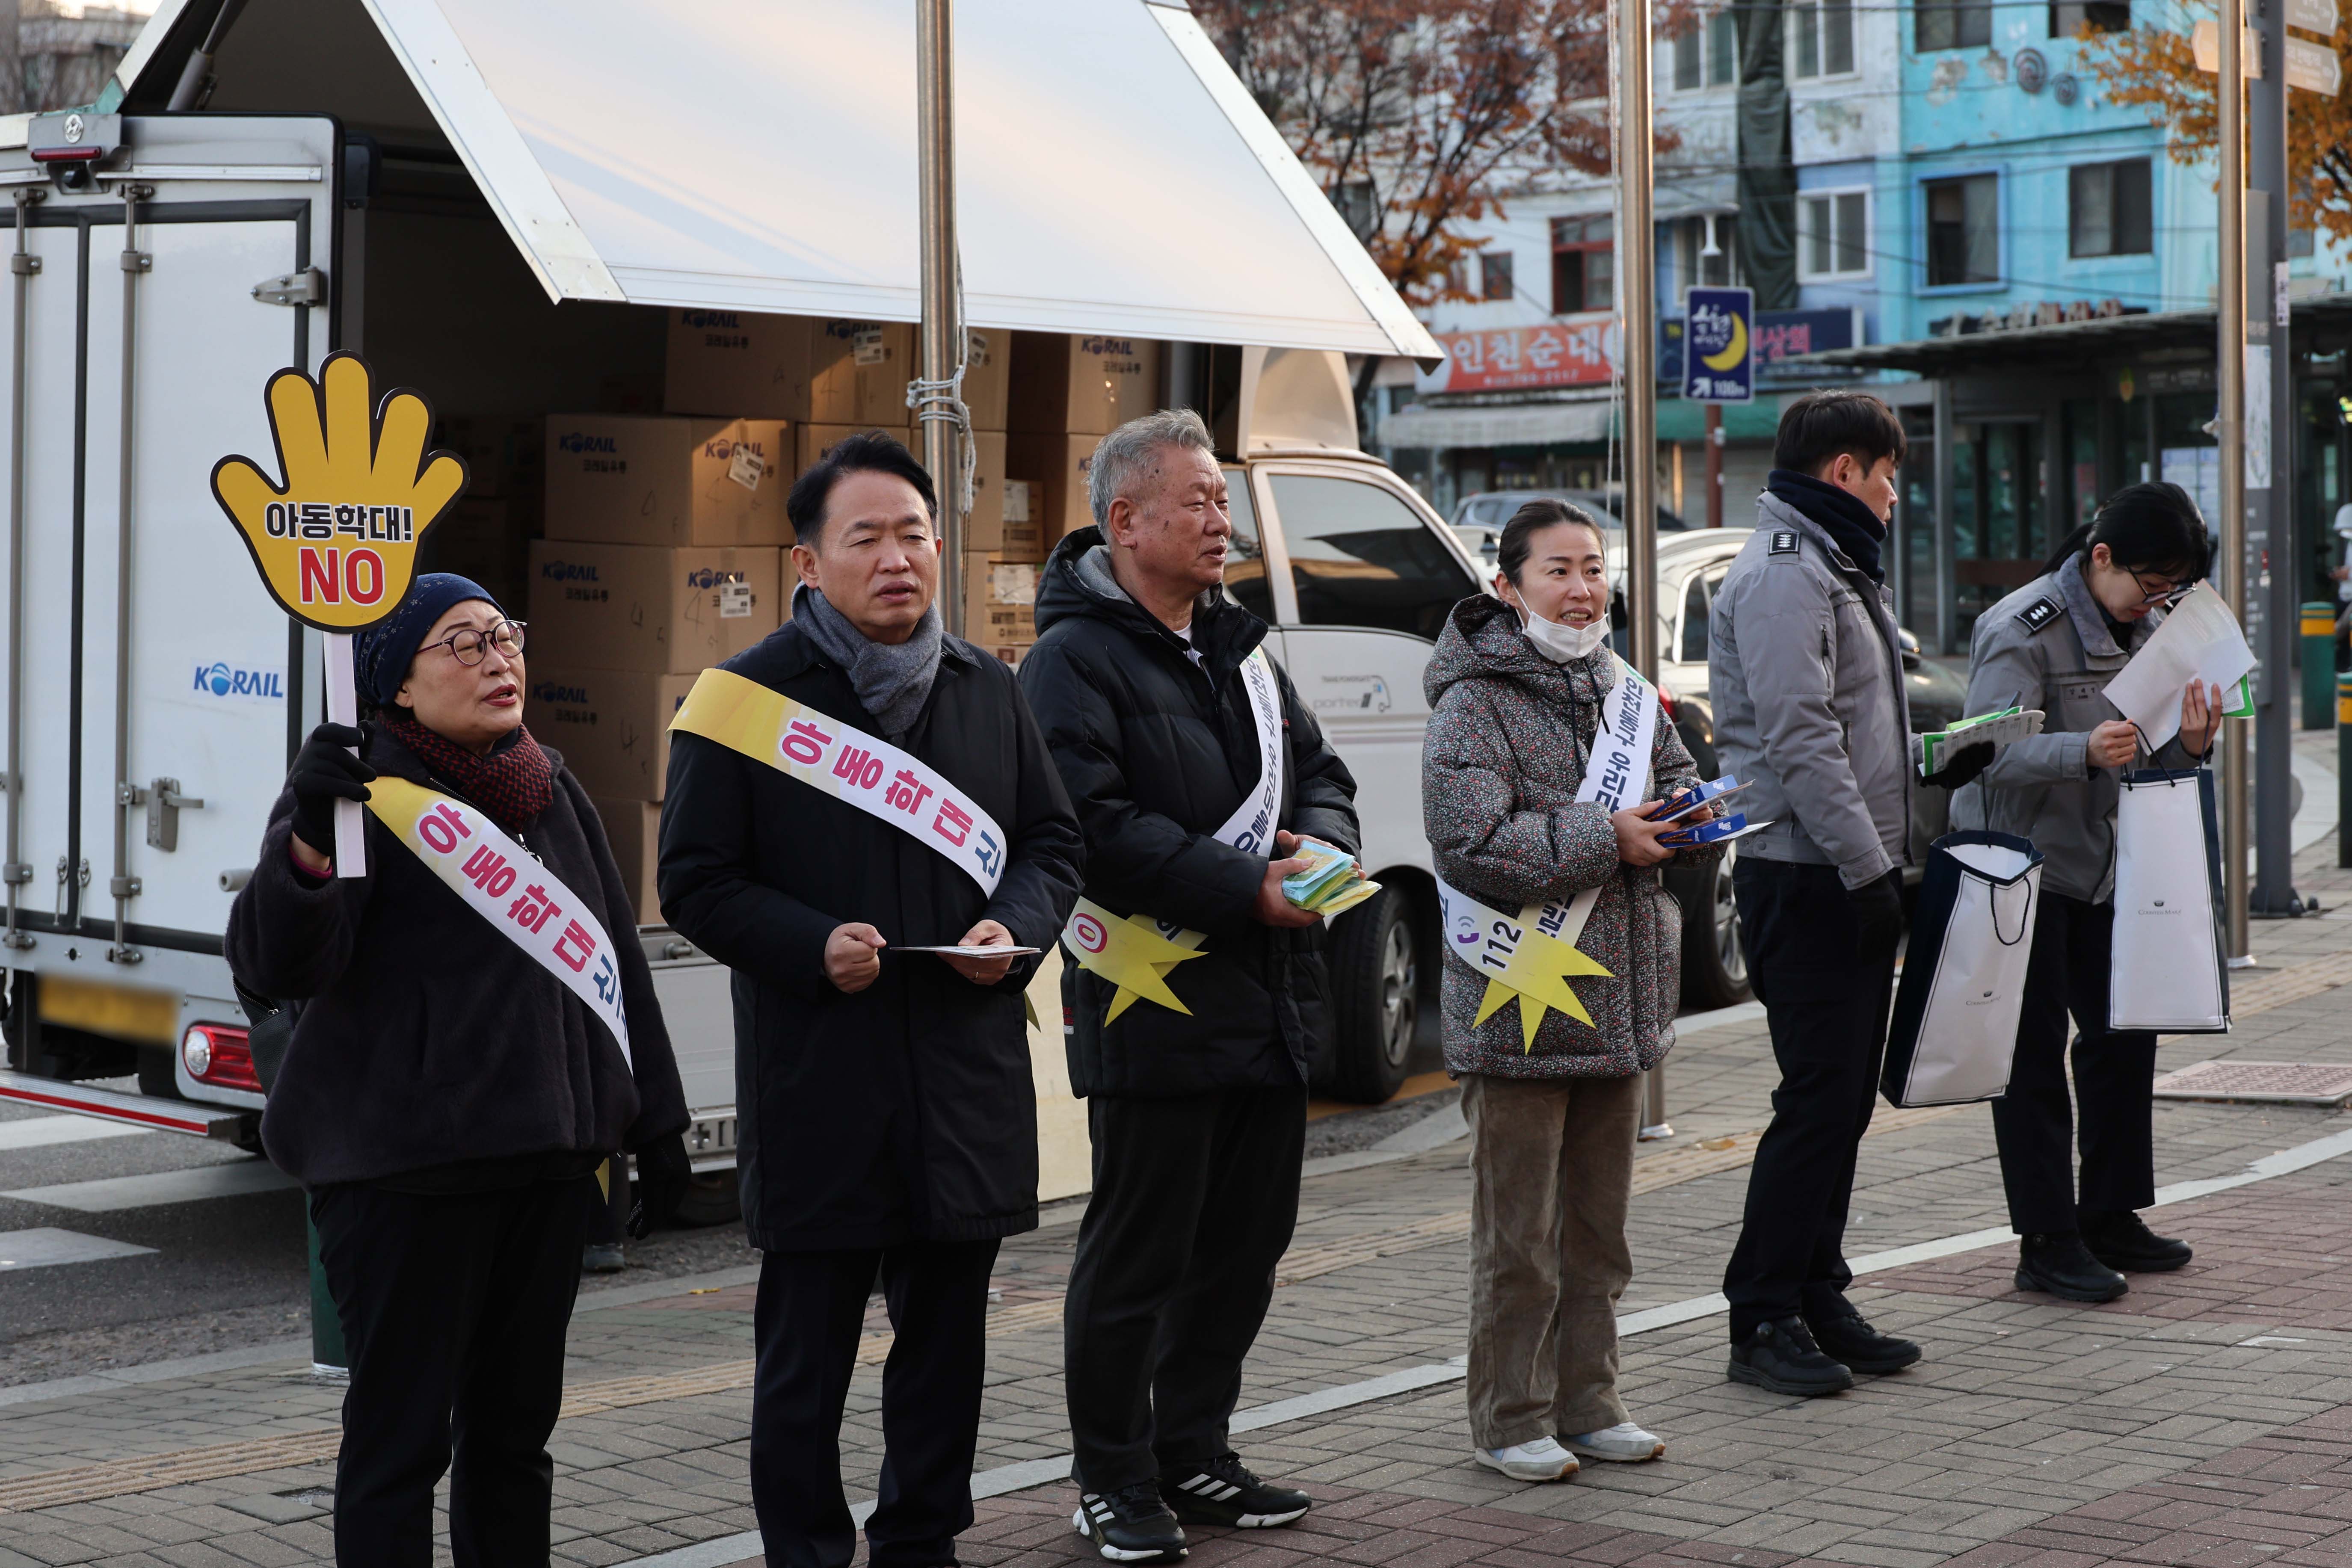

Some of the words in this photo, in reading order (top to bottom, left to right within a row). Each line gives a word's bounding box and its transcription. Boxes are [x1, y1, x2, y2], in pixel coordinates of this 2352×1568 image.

[681, 309, 739, 328] KORAIL
[1081, 336, 1132, 355] KORAIL
[1454, 324, 1601, 373] 인천순대
[559, 432, 617, 453] KORAIL
[266, 502, 413, 542] 아동학대!
[299, 547, 385, 606] NO
[542, 561, 598, 581] KORAIL
[194, 662, 283, 697] KORAIL
[533, 682, 588, 703] KORAIL
[1482, 921, 1522, 969] 112
